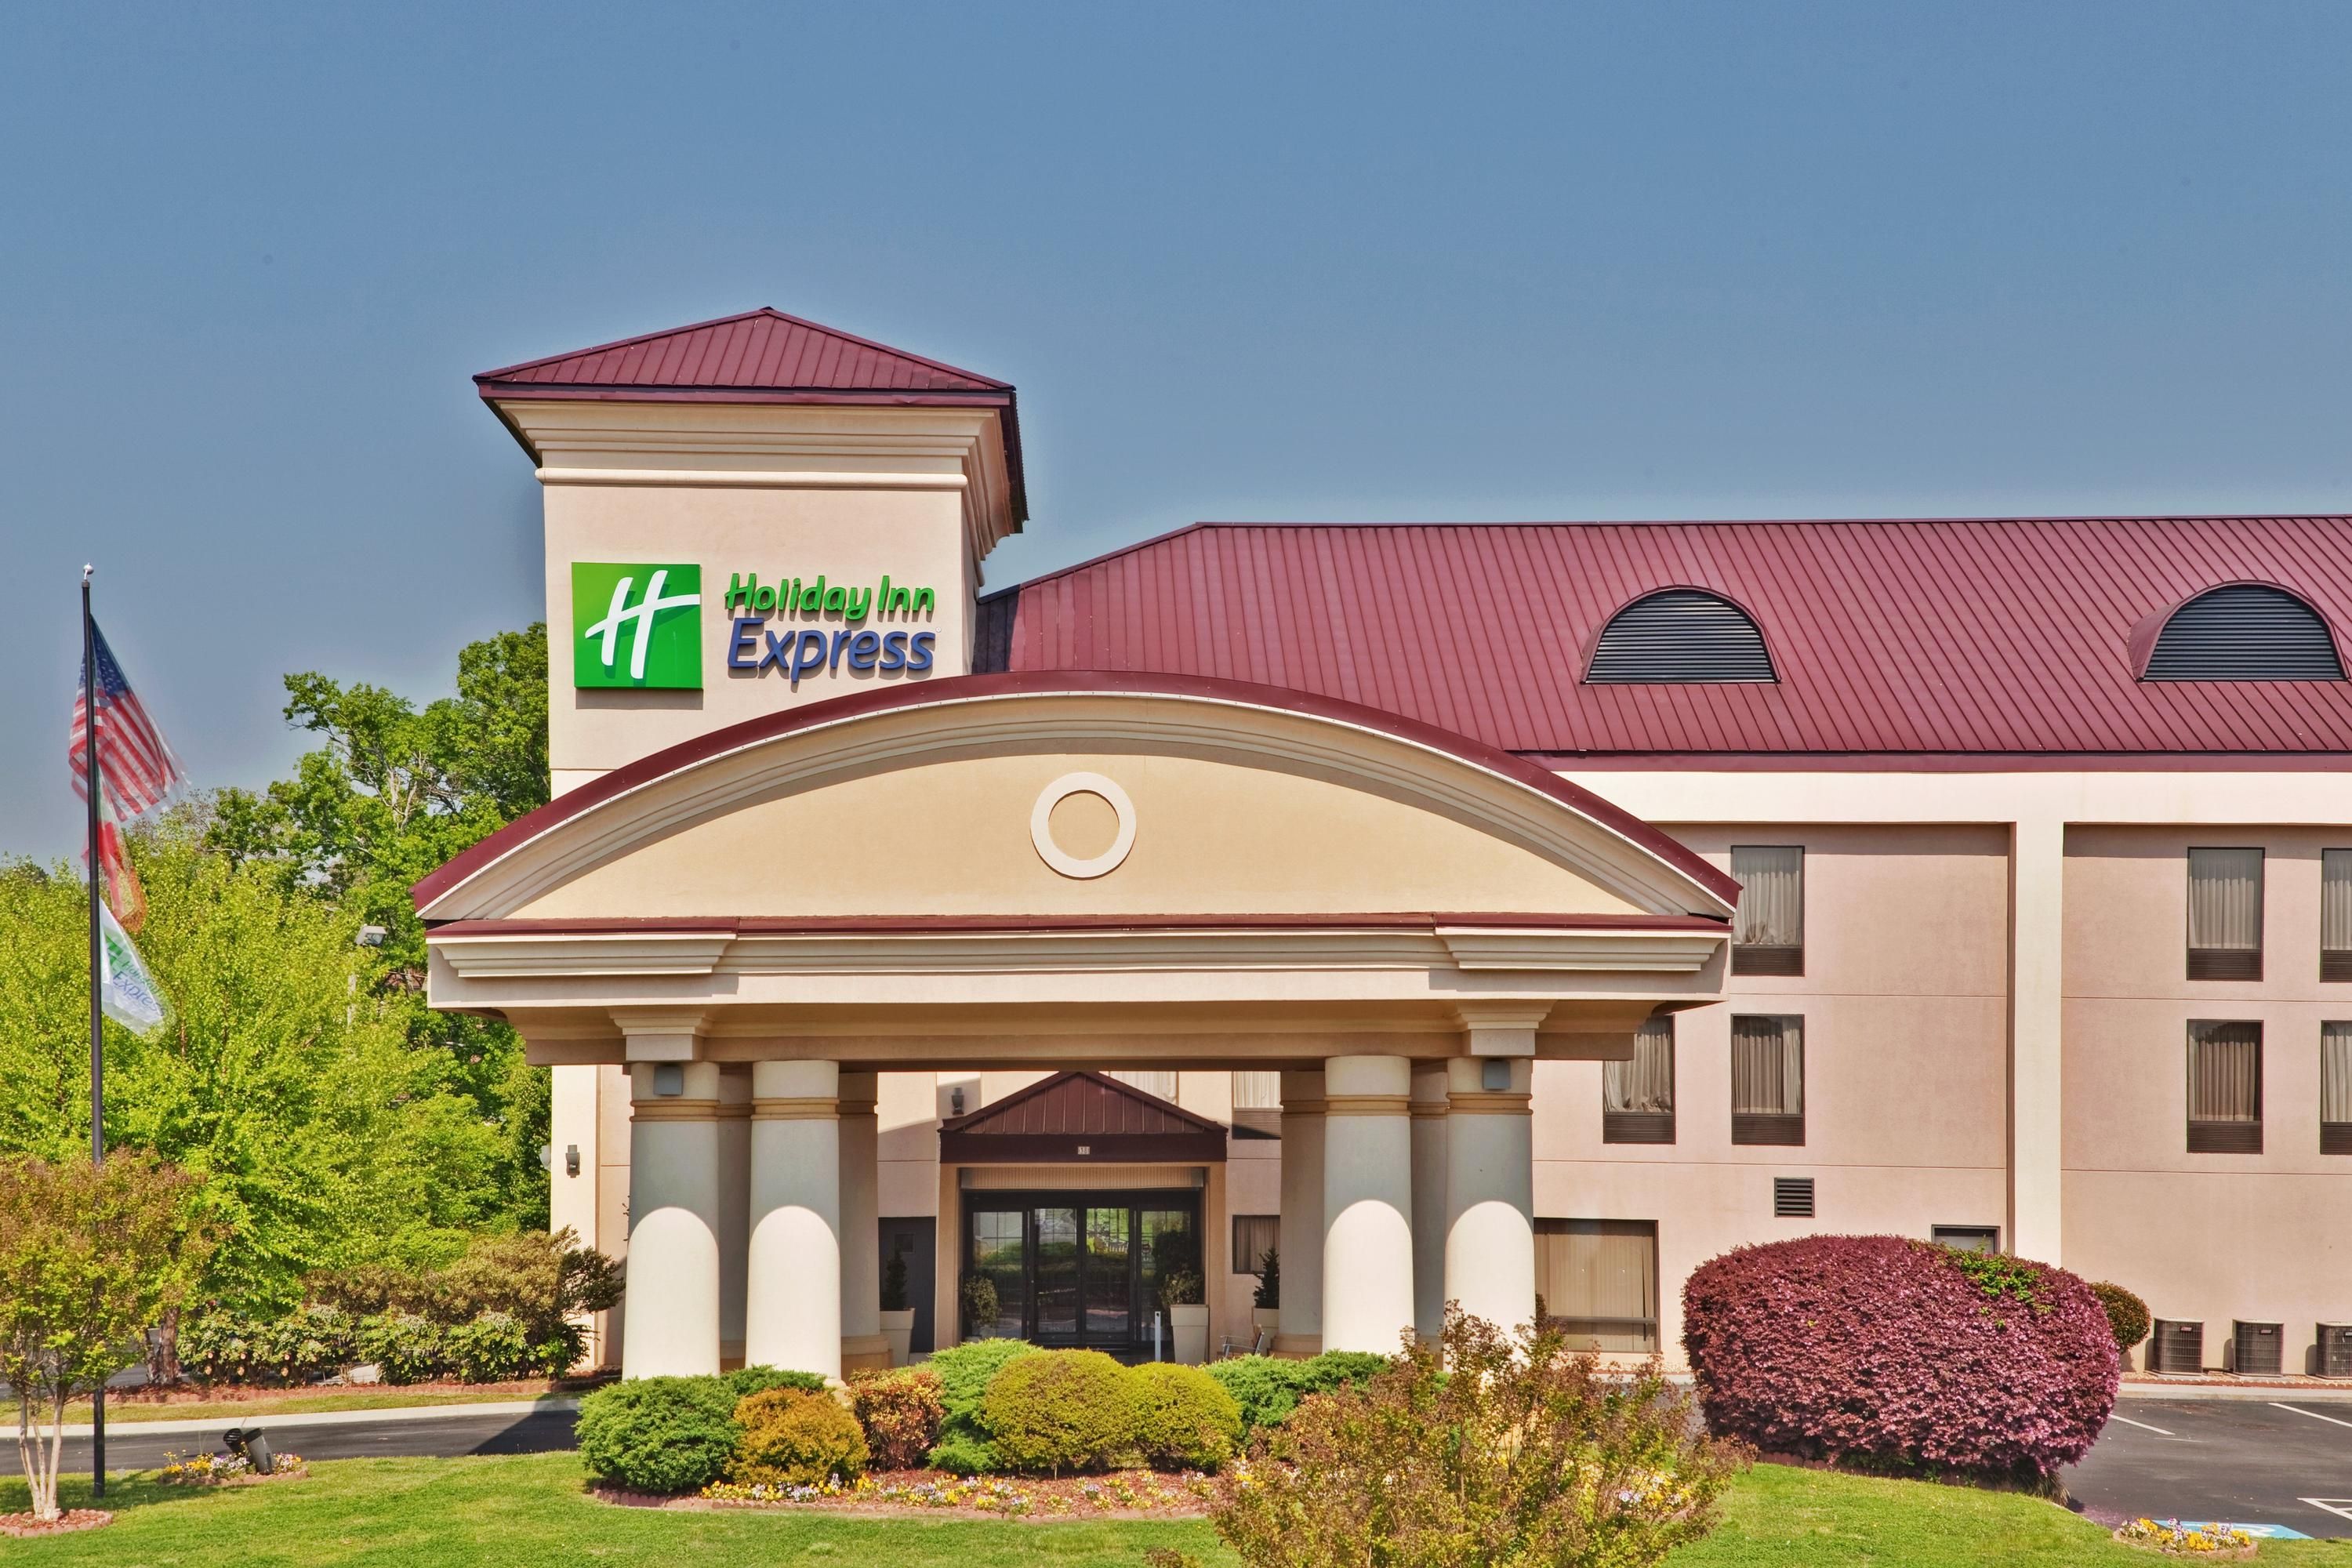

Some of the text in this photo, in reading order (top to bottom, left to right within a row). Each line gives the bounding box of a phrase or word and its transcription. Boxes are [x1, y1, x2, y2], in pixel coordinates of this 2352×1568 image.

[725, 573, 935, 621] Holiday Inn
[728, 617, 936, 683] Express
